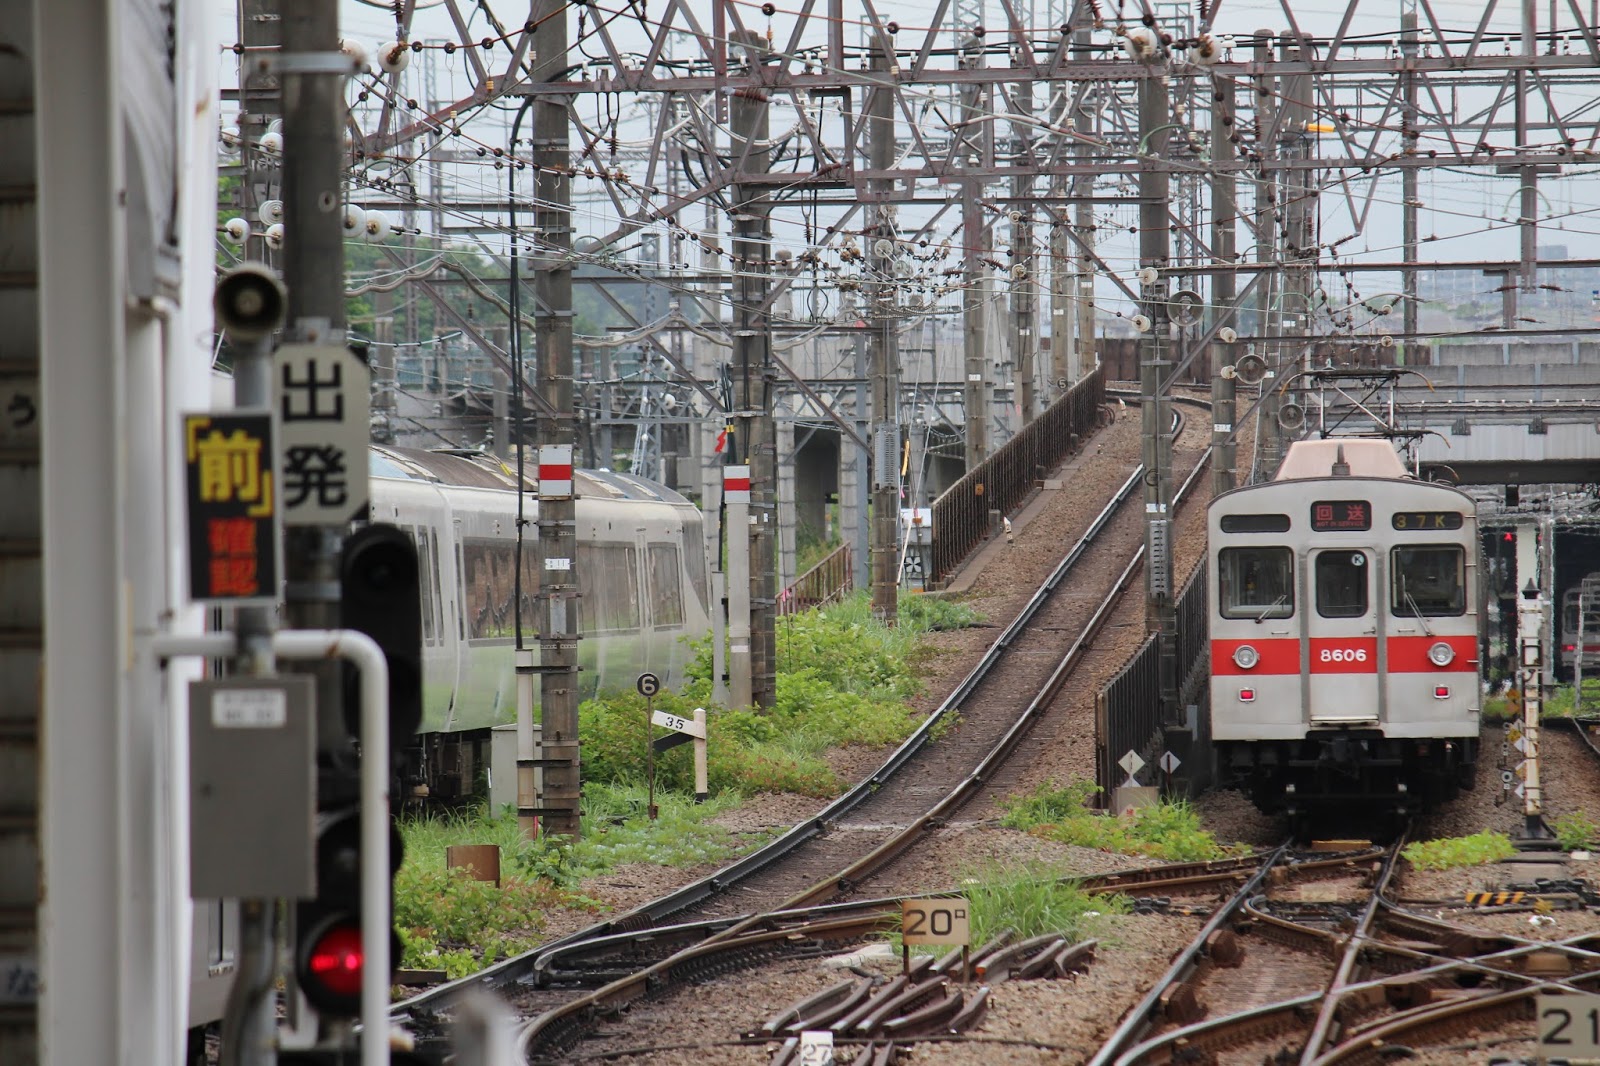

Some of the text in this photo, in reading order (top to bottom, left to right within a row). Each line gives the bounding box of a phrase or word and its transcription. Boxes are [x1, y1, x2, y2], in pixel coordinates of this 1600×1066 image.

[282, 358, 347, 508] 出発
[1316, 504, 1365, 521] 回送
[1354, 556, 1362, 564] K
[1320, 649, 1367, 662] 8606
[641, 676, 656, 694] 6
[665, 716, 685, 730] 35
[1542, 1008, 1598, 1045] 21
[803, 1044, 832, 1061] 27
